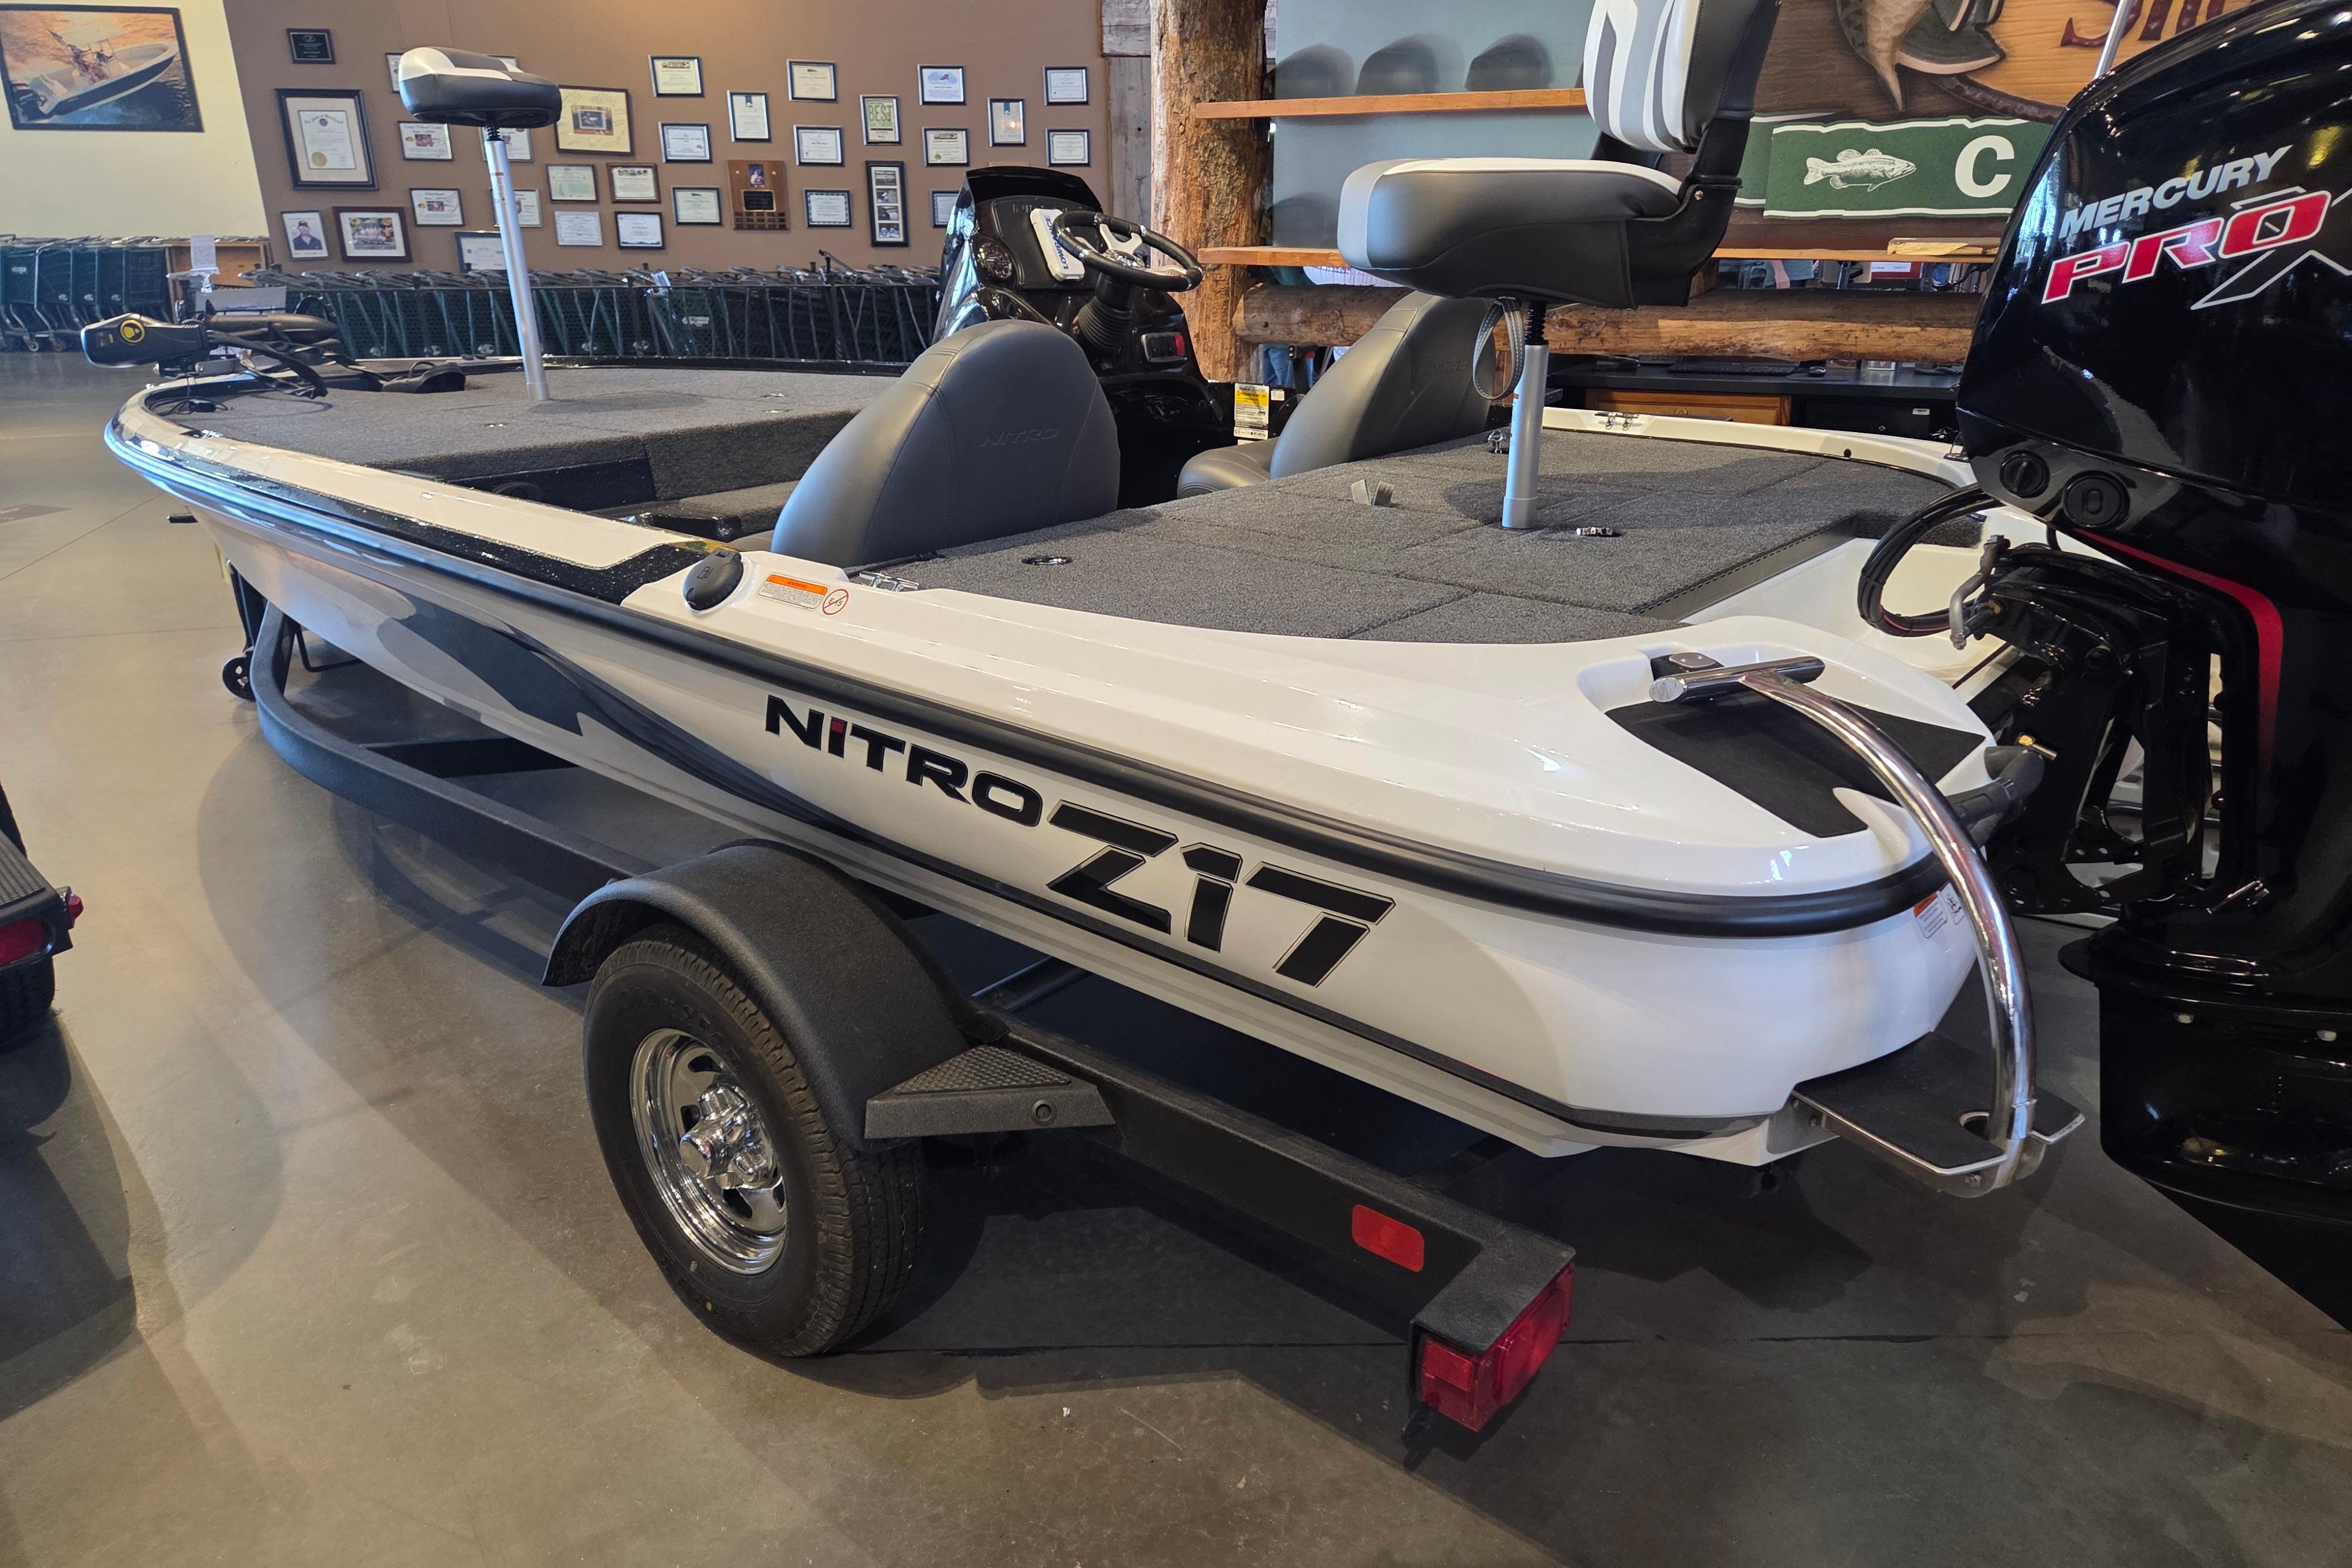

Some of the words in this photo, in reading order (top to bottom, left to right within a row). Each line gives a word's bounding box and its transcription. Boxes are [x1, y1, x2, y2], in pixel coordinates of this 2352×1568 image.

[1955, 135, 2015, 198] C
[2059, 145, 2293, 239] MERCURY
[2042, 191, 2332, 304] PRO
[978, 426, 1061, 447] NITRO
[765, 695, 1043, 827] NITRO
[1046, 800, 1396, 988] Z17
